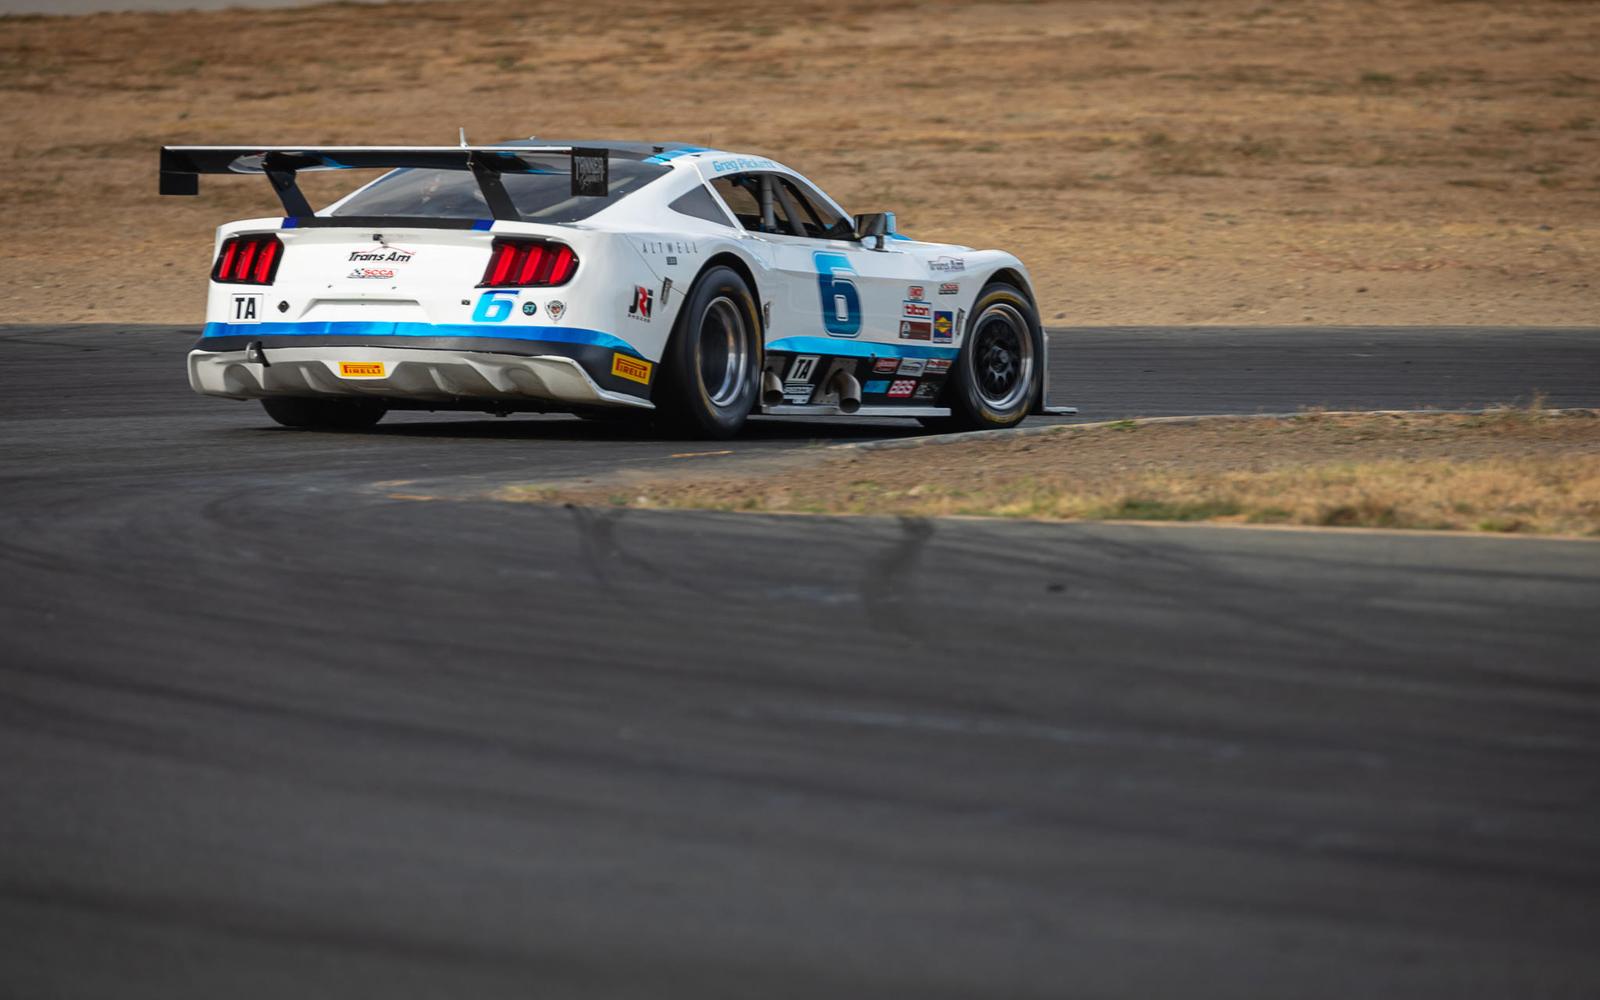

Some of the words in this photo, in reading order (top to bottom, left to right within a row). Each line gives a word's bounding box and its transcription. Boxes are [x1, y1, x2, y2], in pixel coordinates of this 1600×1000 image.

[712, 159, 739, 172] Greg
[642, 241, 698, 254] ALTWELL
[348, 252, 385, 262] Trans
[385, 251, 412, 262] Am
[363, 268, 394, 278] SCCA
[813, 250, 863, 338] 6
[235, 297, 256, 319] TA
[472, 290, 520, 322] 6
[523, 304, 536, 313] 57
[343, 364, 382, 374] PIRELLI
[615, 357, 649, 379] PIRELLI
[792, 359, 813, 379] TA
[887, 379, 917, 395] BBS
